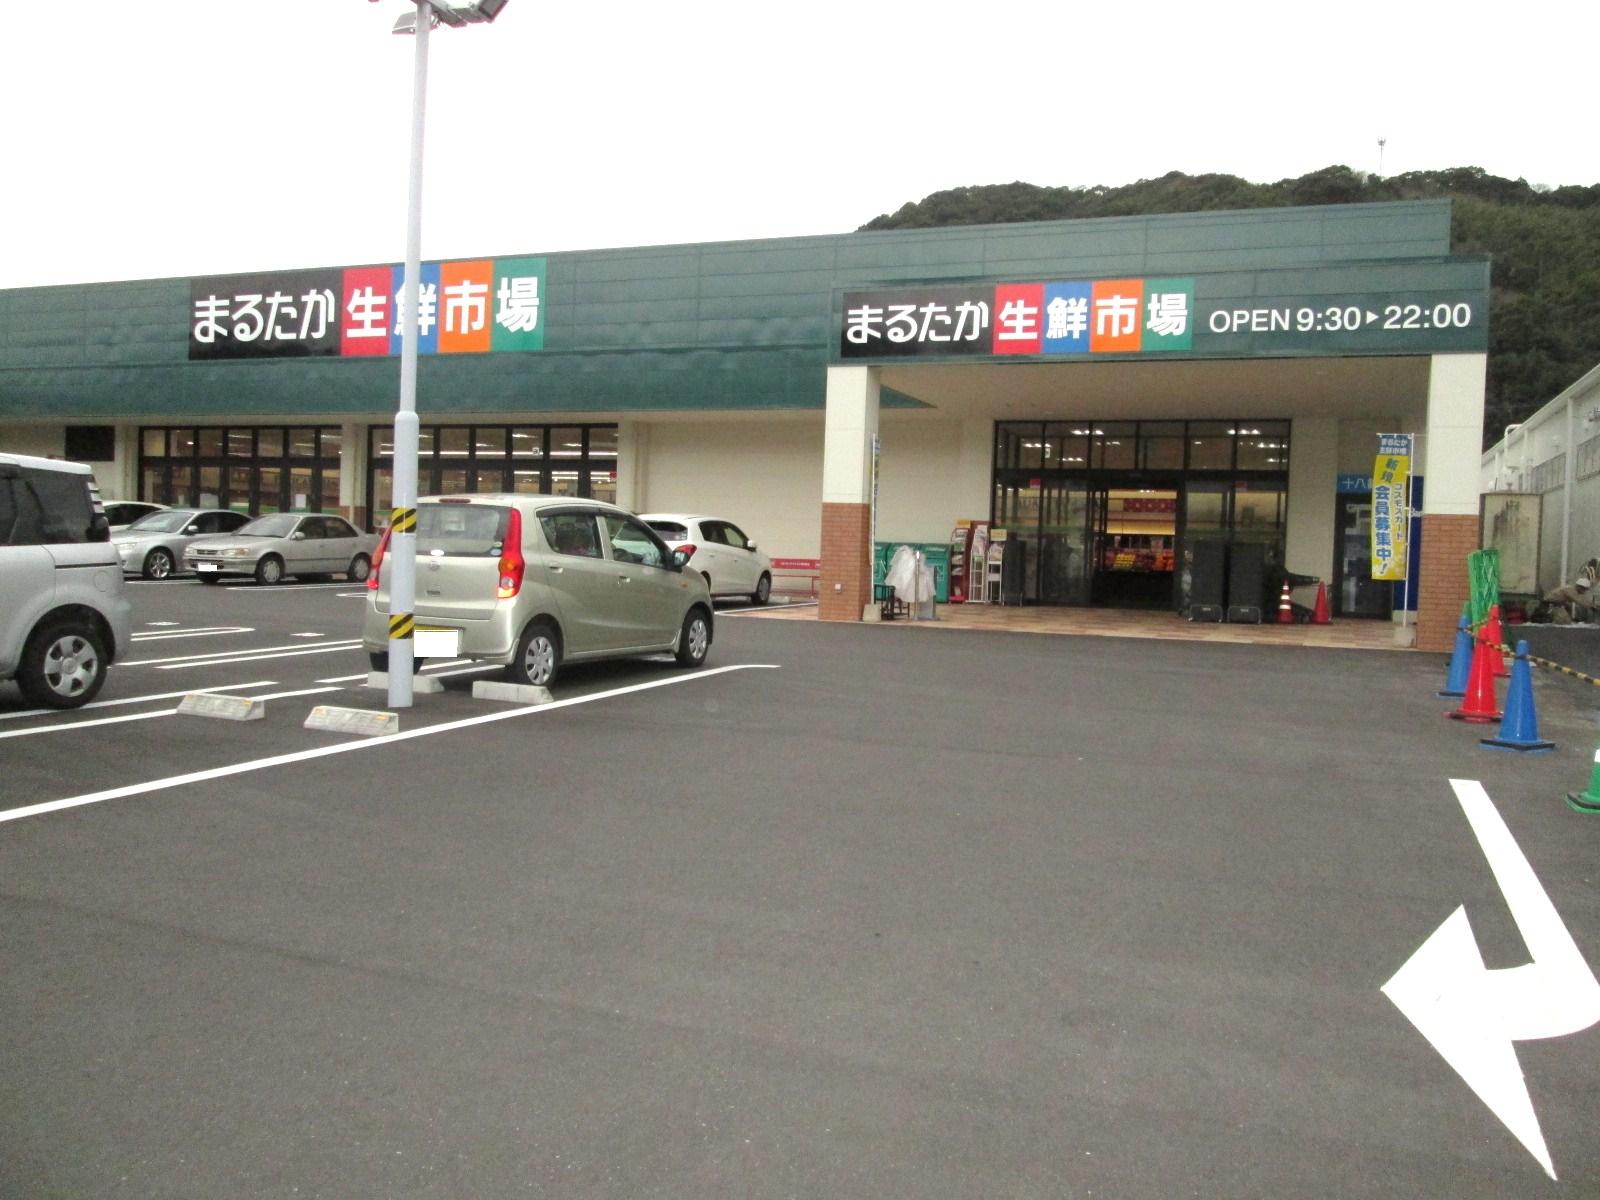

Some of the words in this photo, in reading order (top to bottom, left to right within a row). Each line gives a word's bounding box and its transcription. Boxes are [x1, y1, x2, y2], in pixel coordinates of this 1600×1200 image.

[846, 293, 1189, 344] まるたか生鮮市場
[1208, 307, 1290, 334] OPEN
[1296, 306, 1361, 332] 9:30
[1383, 303, 1471, 330] 22:00
